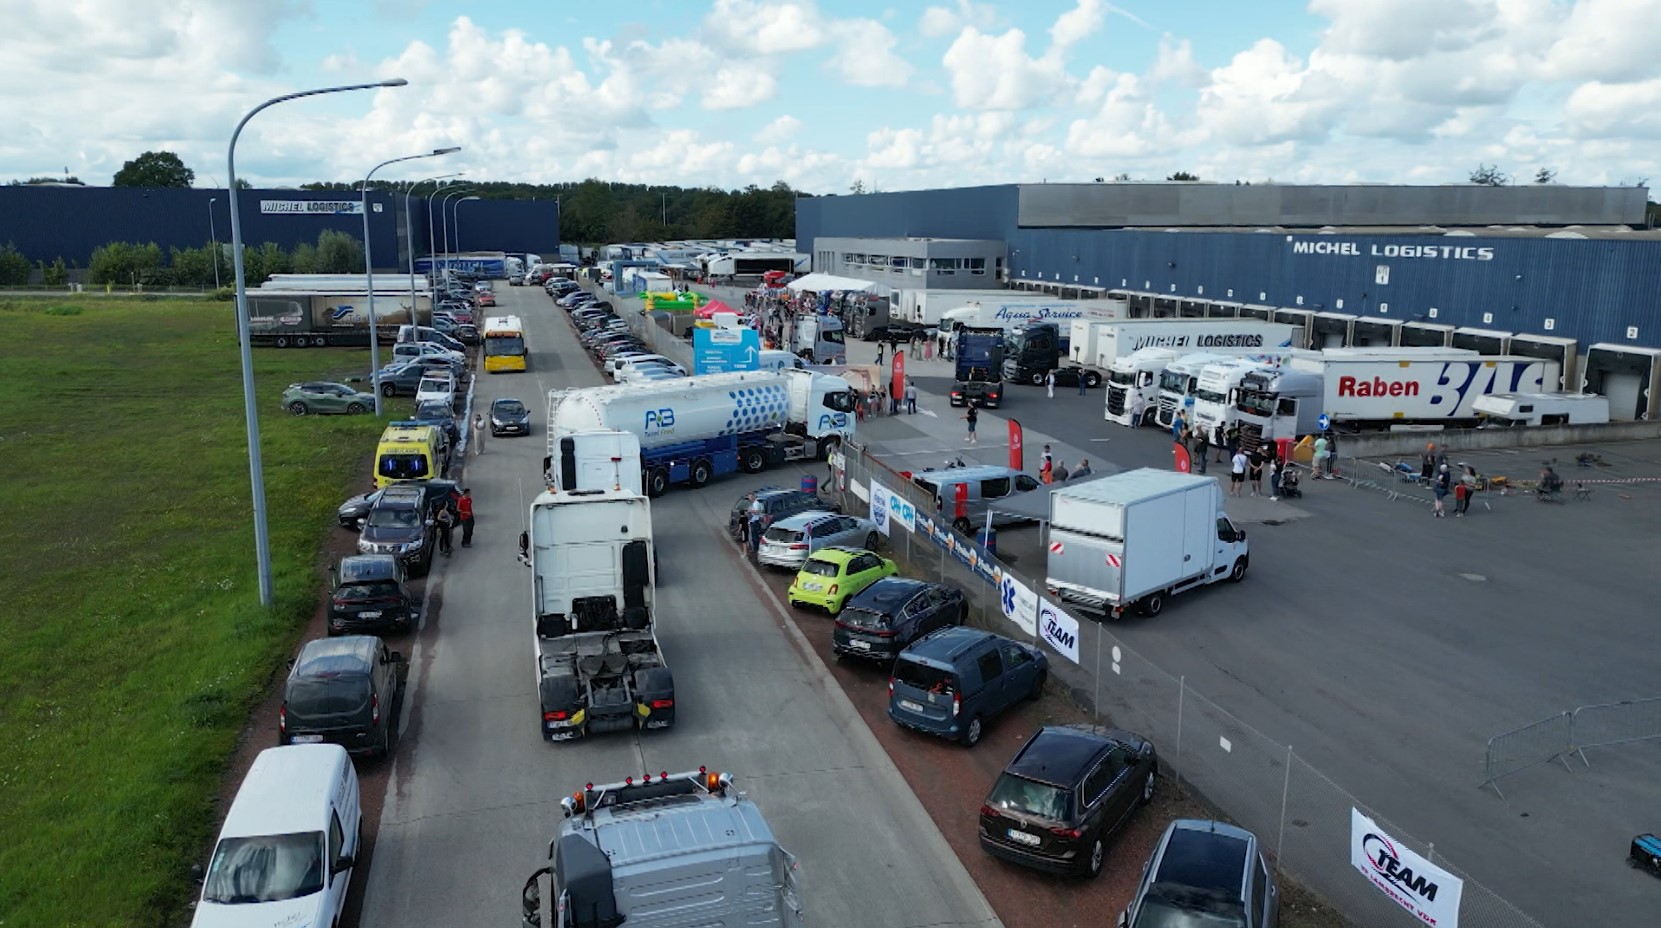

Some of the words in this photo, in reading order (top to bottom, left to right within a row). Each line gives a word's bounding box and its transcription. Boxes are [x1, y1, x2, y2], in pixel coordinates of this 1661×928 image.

[263, 202, 303, 212] MICHEL
[307, 202, 354, 213] LOGISTICS
[1293, 241, 1361, 256] MICHEL
[1370, 243, 1495, 261] LOGISTICS
[1197, 334, 1264, 348] LOGISTICS
[1338, 375, 1420, 398] Raben
[1047, 618, 1075, 650] TEAM
[1377, 848, 1439, 902] TEAM
